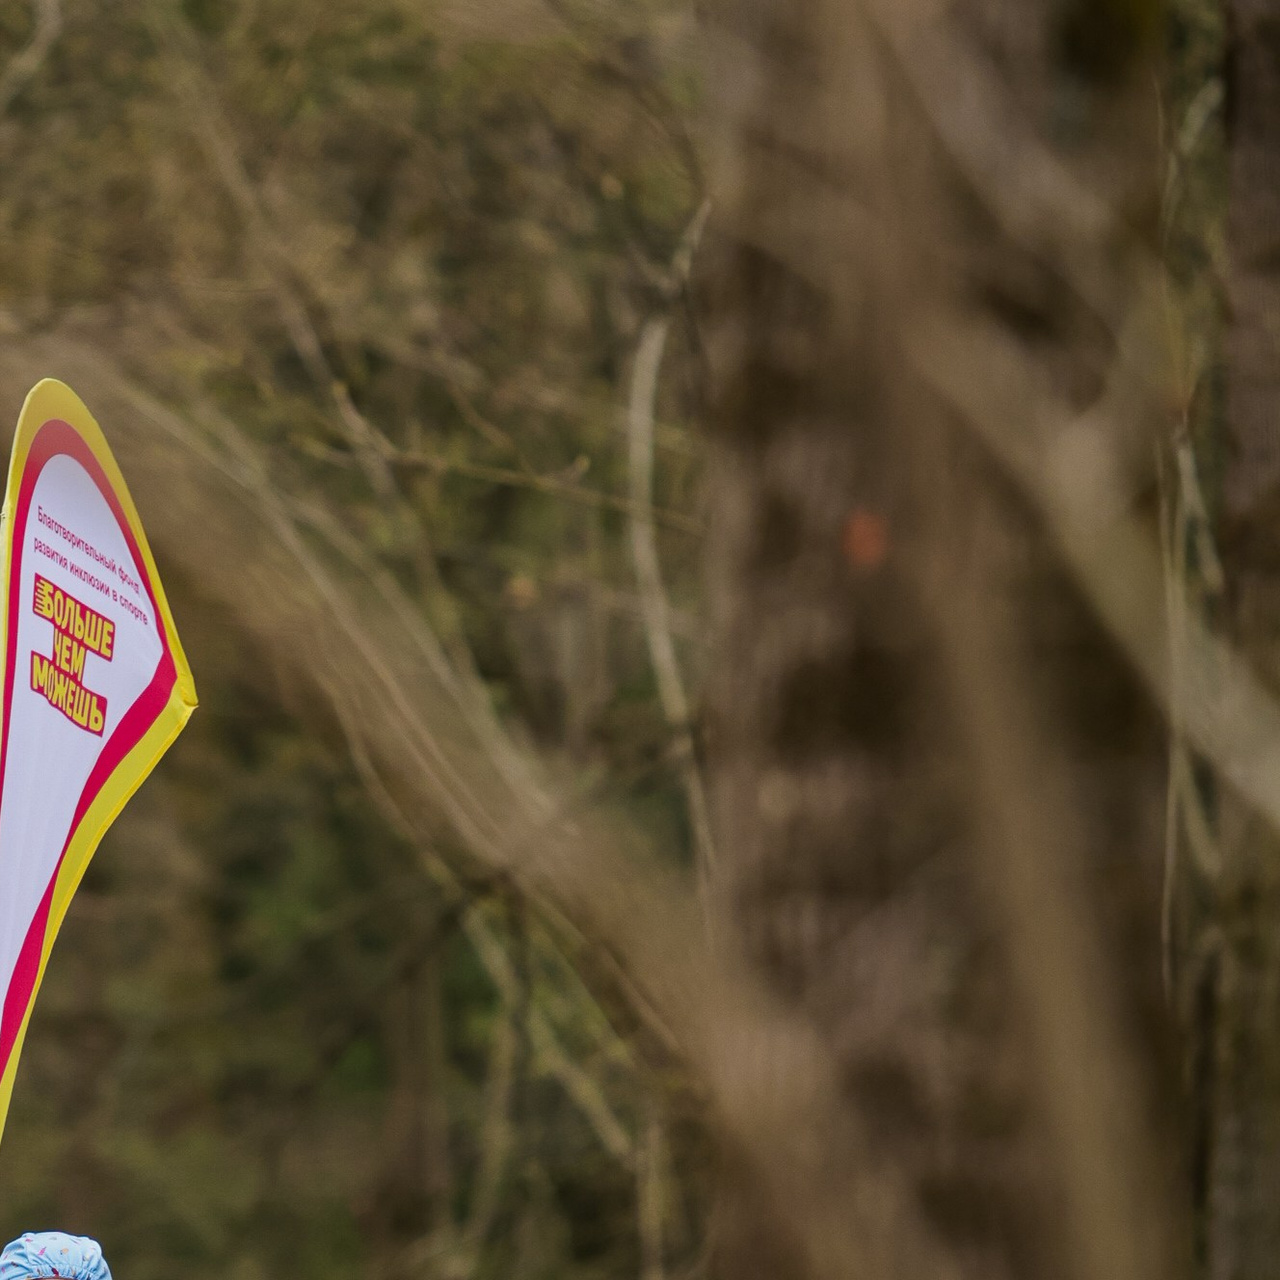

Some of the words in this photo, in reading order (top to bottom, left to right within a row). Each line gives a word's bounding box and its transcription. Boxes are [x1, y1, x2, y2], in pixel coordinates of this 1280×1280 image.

[37, 505, 117, 575] Благотворительный
[33, 537, 68, 571] развития
[69, 561, 110, 598] инклюзии
[111, 589, 118, 603] в
[119, 595, 148, 626] спорте
[34, 578, 115, 658] БОЛЬШЕ
[32, 653, 105, 733] МОЖЕШЬ
[53, 628, 87, 681] ЧЕМ
